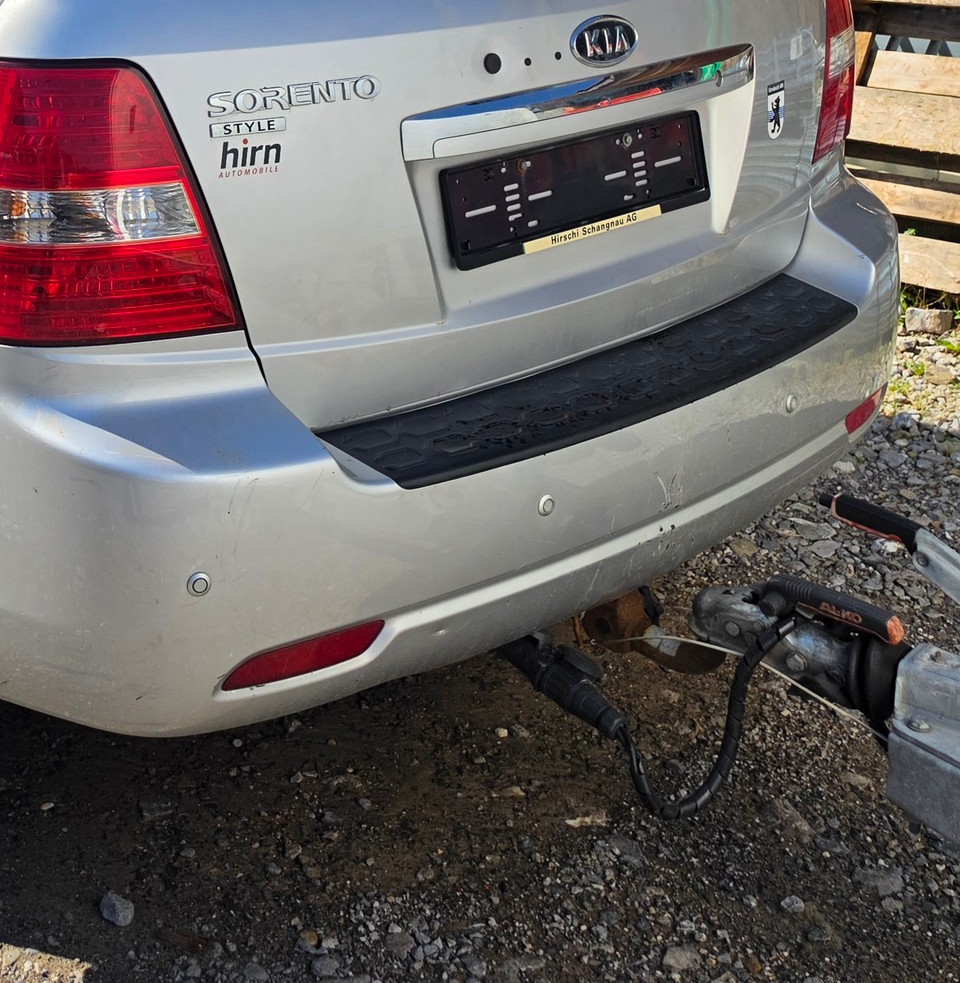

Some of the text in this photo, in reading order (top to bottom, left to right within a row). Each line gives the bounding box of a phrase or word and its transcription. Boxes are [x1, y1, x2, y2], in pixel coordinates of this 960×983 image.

[583, 26, 631, 57] KIA
[207, 74, 381, 118] SORENTO
[223, 119, 276, 135] STYLE
[220, 138, 282, 169] hirn
[218, 165, 279, 179] AUTOMOBILE
[551, 212, 638, 245] Hirschi Schangnau AG
